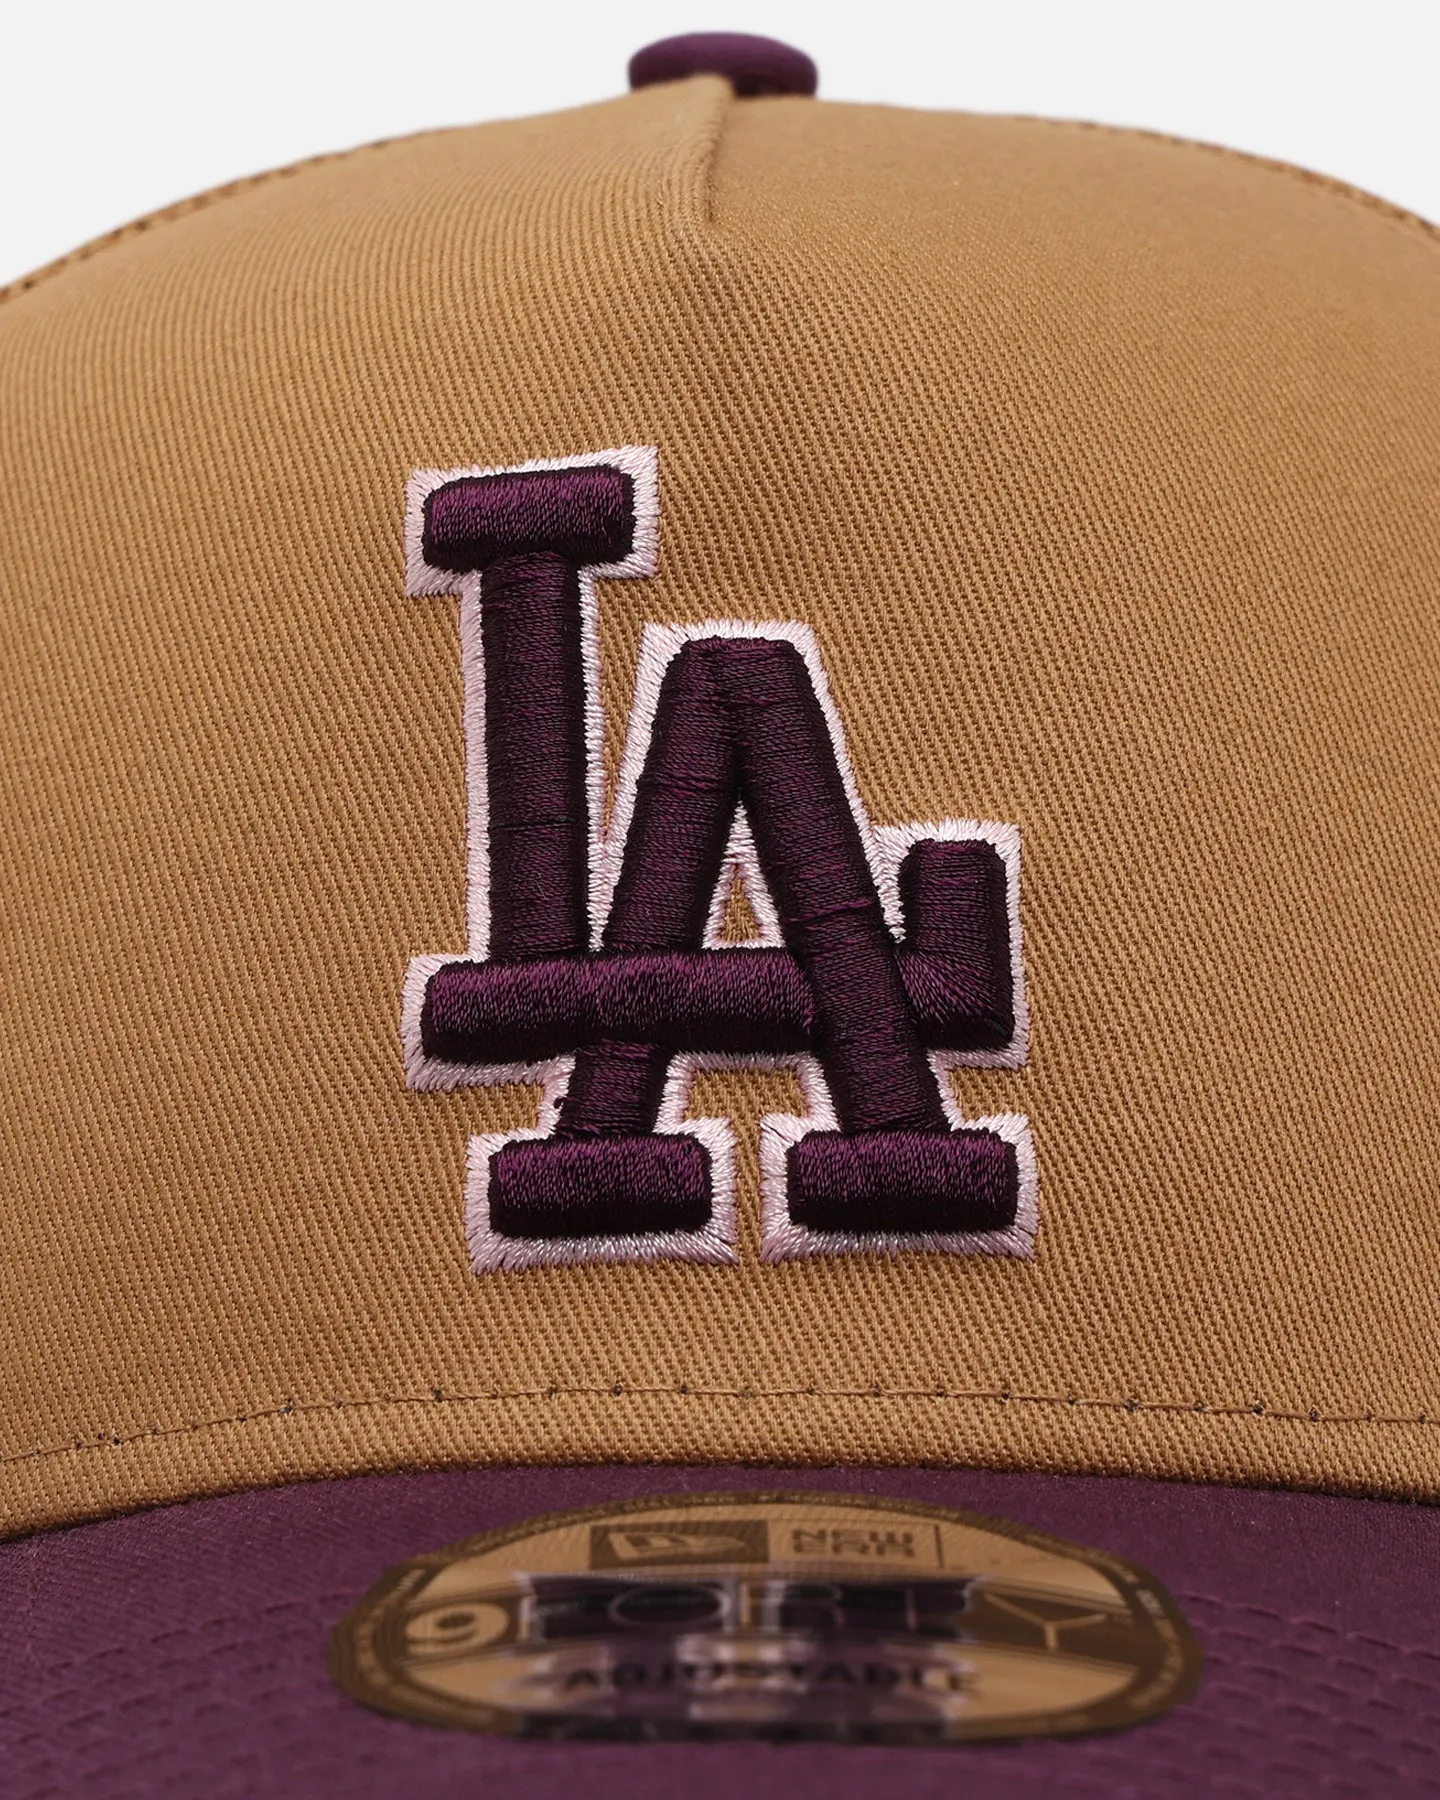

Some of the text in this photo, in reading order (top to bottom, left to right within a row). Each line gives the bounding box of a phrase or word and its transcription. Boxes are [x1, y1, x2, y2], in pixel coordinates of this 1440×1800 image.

[403, 446, 1037, 1272] LA
[792, 1528, 912, 1543] NEW
[794, 1541, 914, 1557] ERA
